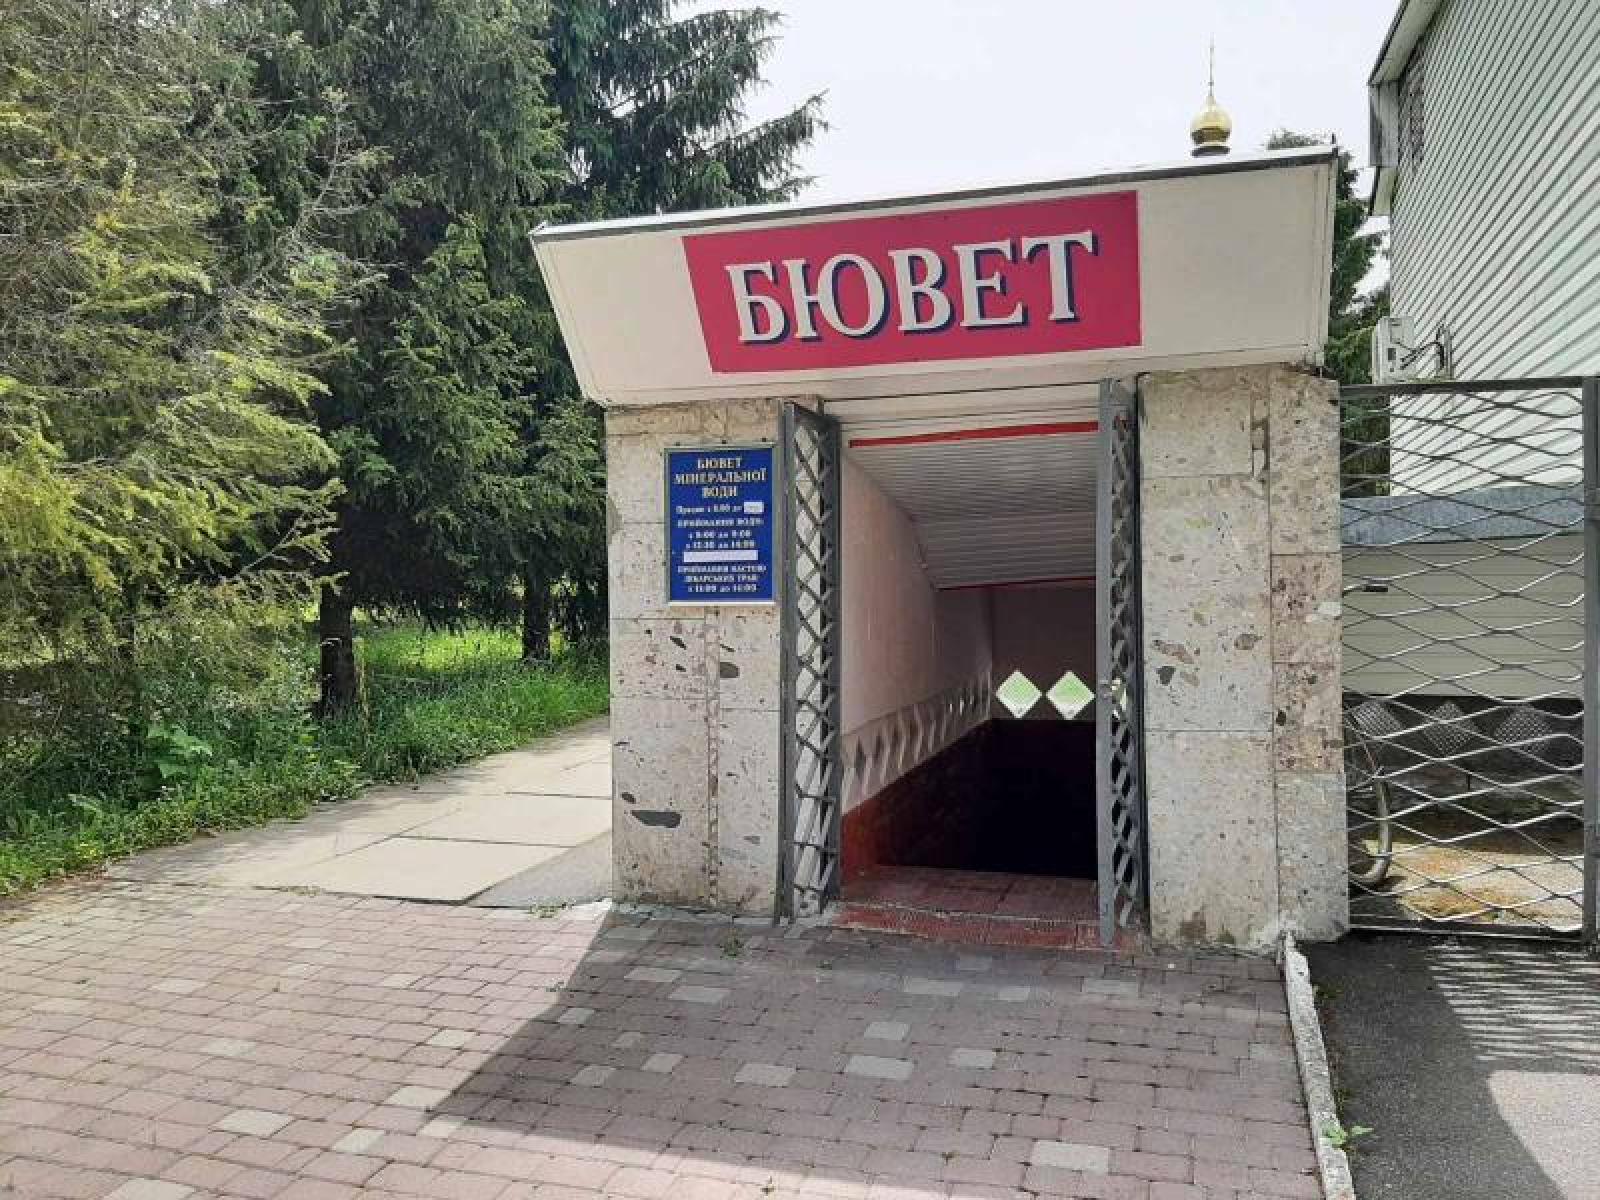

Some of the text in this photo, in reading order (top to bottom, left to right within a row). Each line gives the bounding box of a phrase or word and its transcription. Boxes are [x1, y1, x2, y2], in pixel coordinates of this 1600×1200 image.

[724, 229, 1099, 346] БЮВЕТ
[697, 457, 742, 469] БЮВЕТ
[674, 468, 766, 485] МІНЕРАЛЬНОЇ
